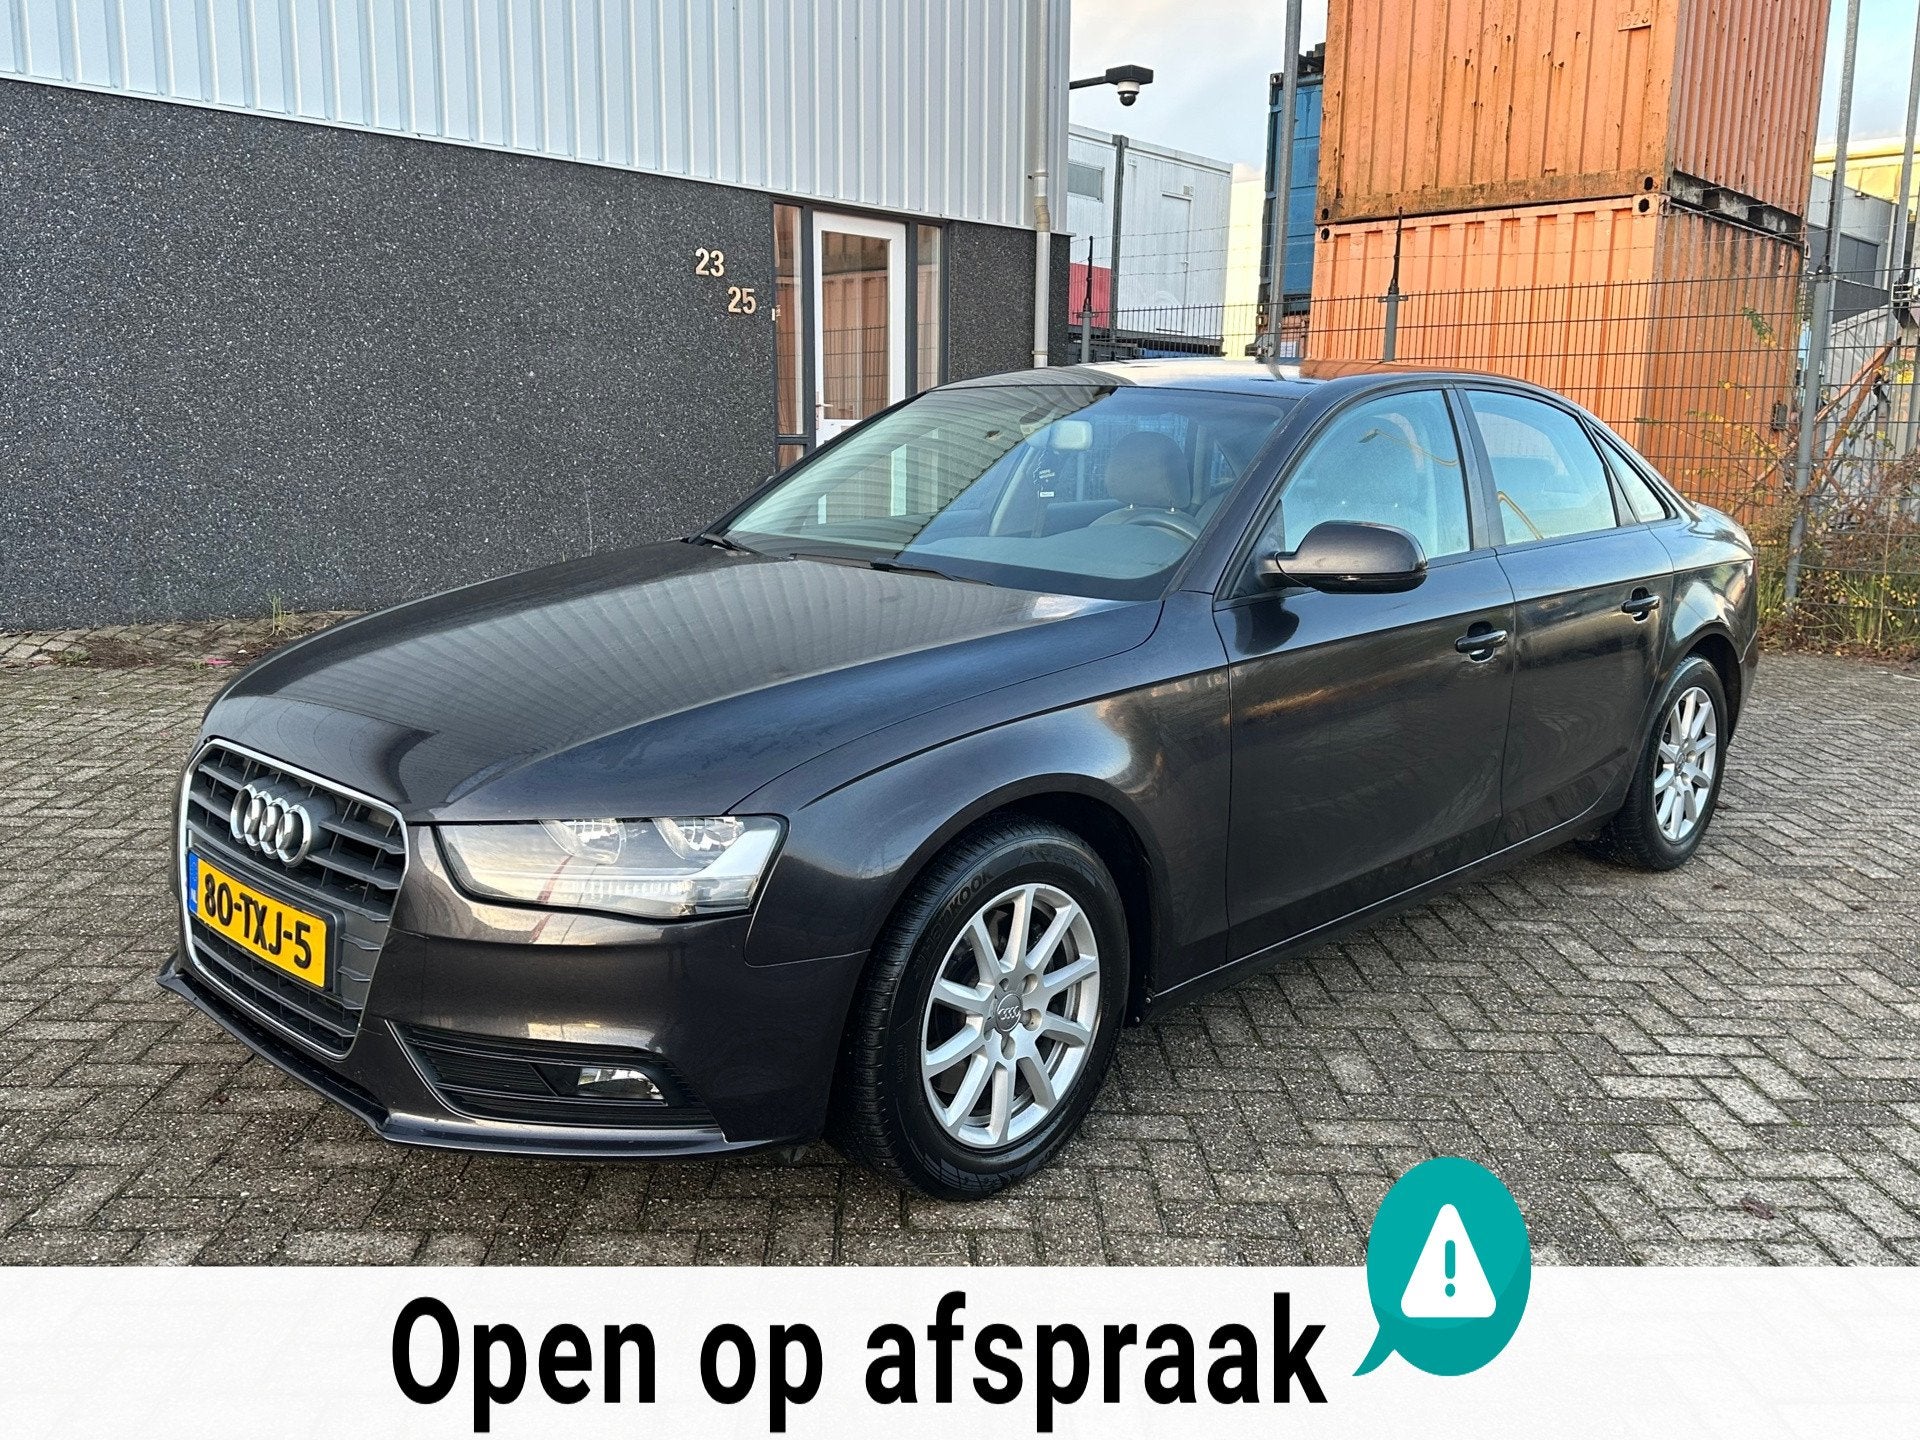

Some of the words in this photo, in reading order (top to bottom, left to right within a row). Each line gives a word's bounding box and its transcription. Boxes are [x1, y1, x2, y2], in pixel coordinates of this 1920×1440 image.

[695, 247, 725, 277] 23
[727, 286, 757, 314] 25
[204, 872, 313, 970] 80-TXJ-5
